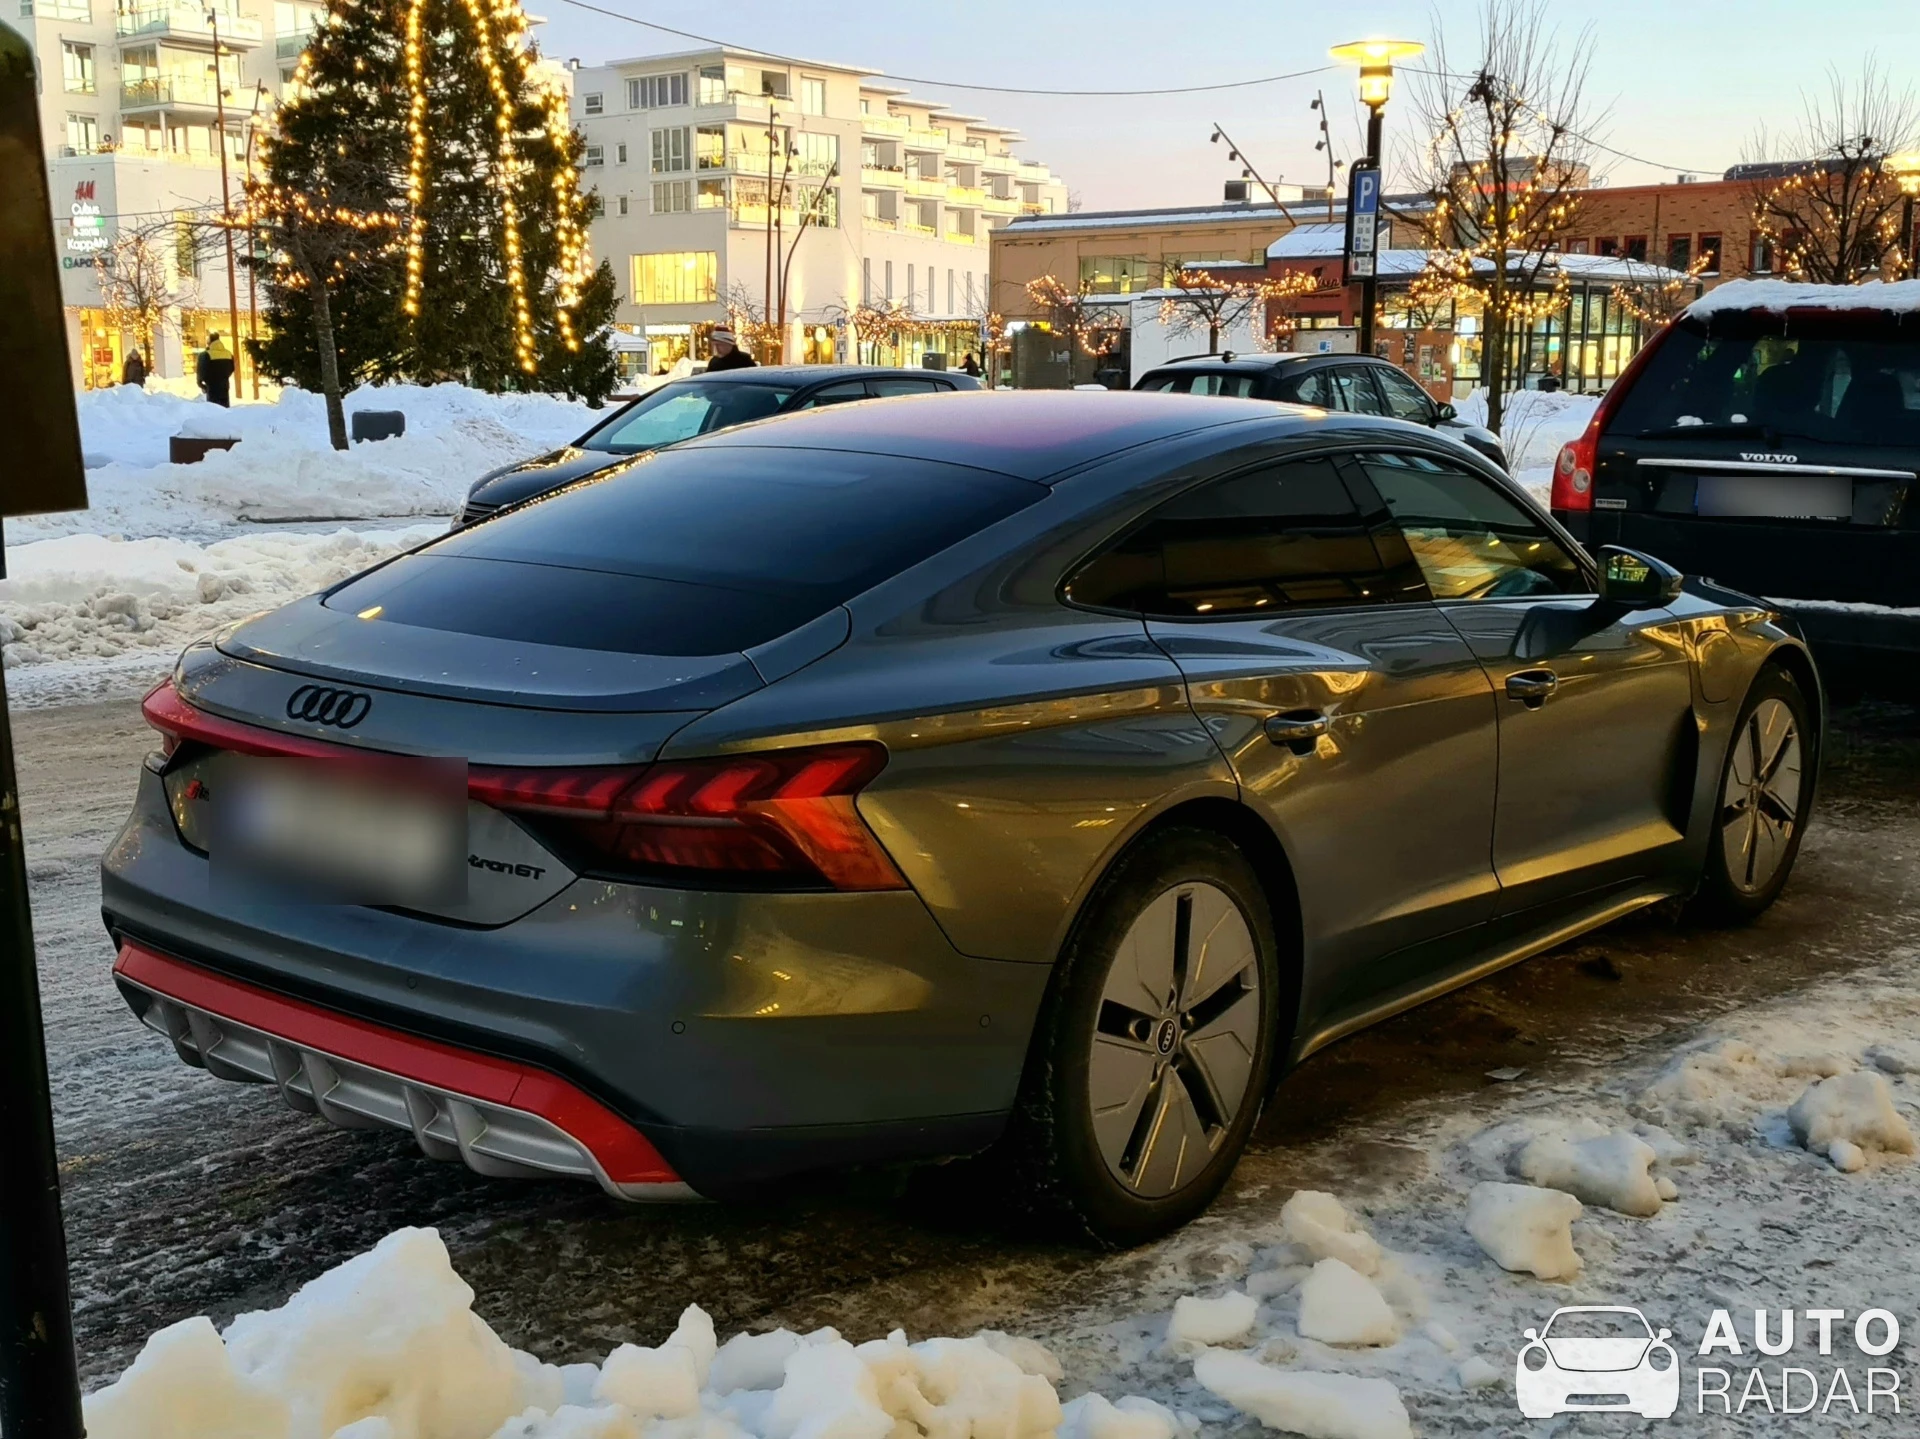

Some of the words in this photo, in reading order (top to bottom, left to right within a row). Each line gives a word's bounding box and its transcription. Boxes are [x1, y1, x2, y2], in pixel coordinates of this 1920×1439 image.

[1360, 176, 1374, 209] P
[71, 202, 100, 216] Cubus
[1740, 453, 1798, 464] VOLVO
